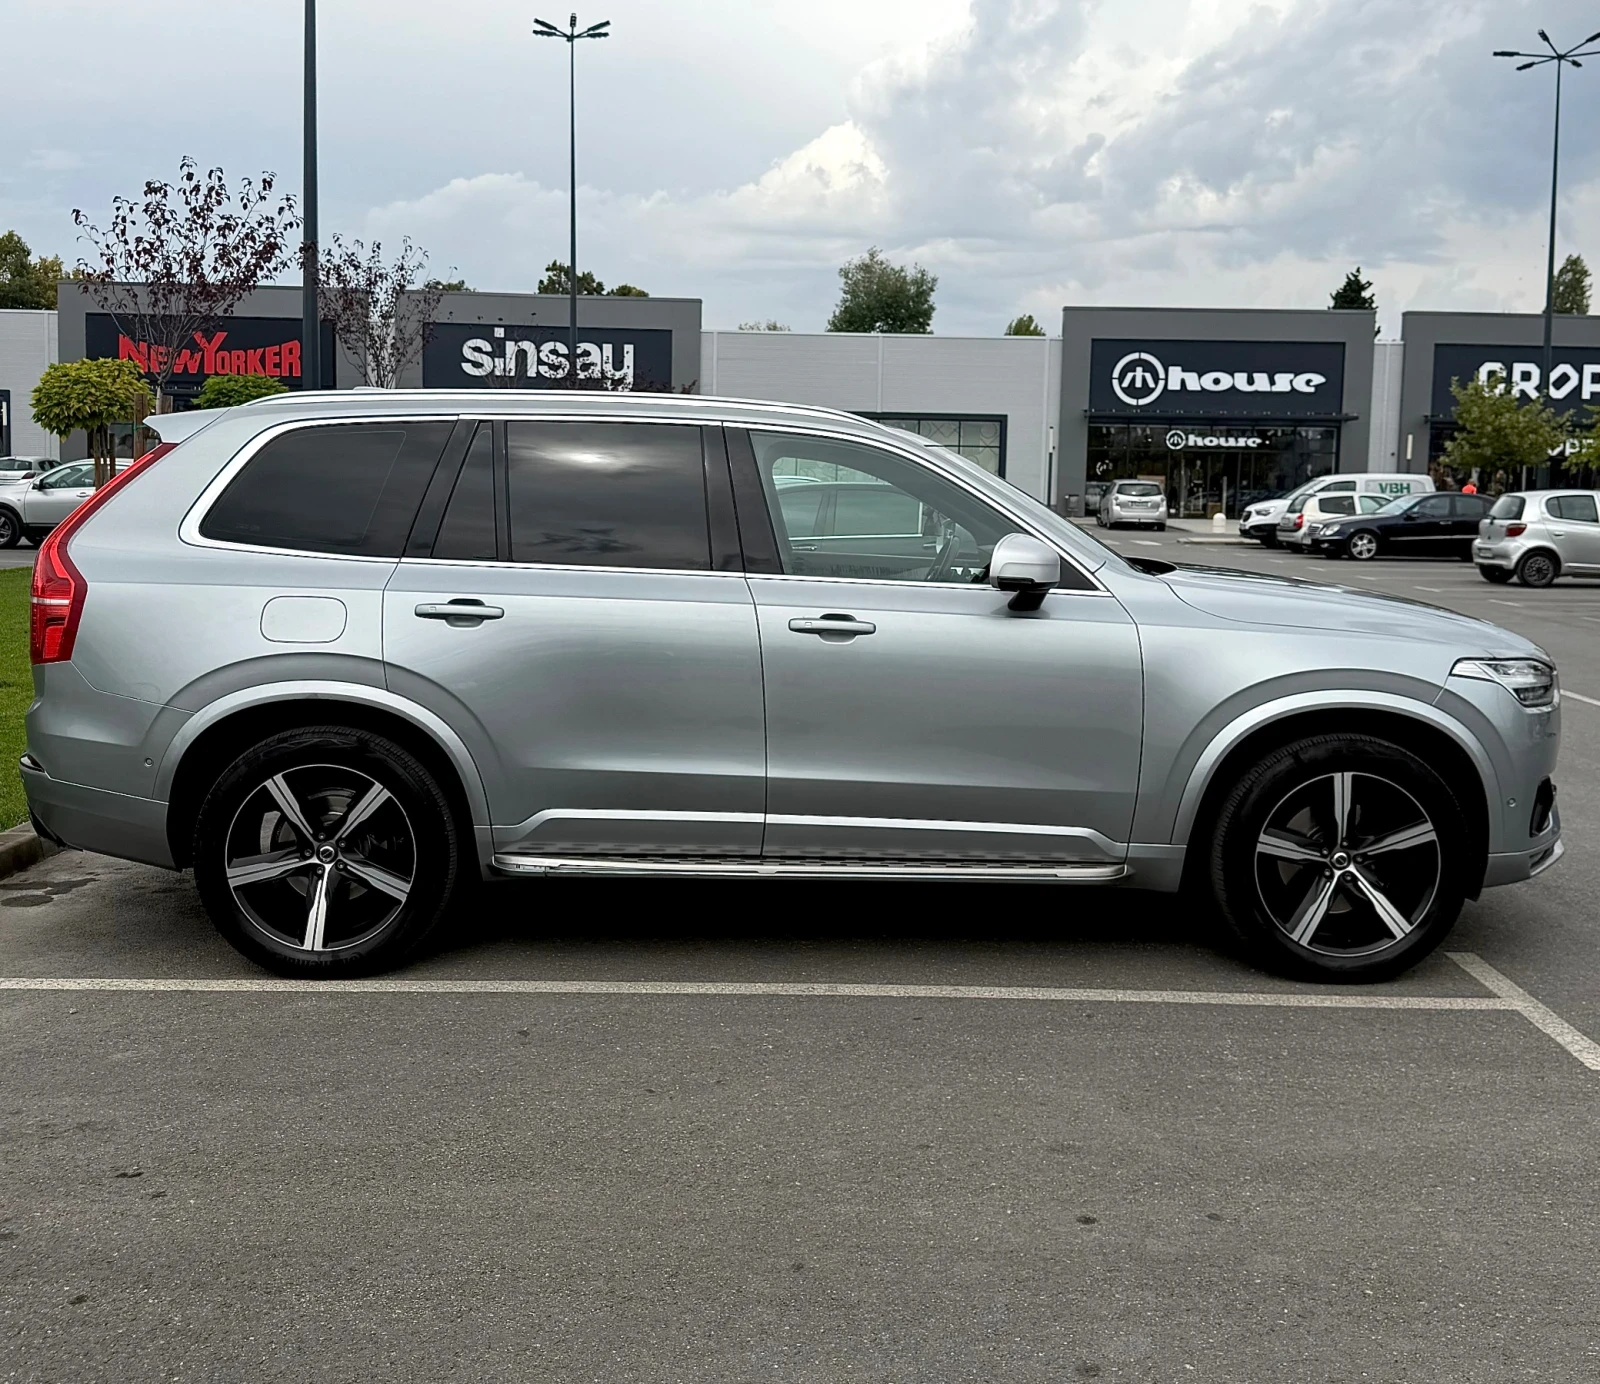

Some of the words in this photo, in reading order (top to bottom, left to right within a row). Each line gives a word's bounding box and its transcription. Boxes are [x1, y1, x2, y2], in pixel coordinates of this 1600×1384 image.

[461, 327, 634, 392] sinsay
[1167, 366, 1327, 393] house
[1187, 434, 1262, 447] house
[1379, 482, 1411, 494] VBH
